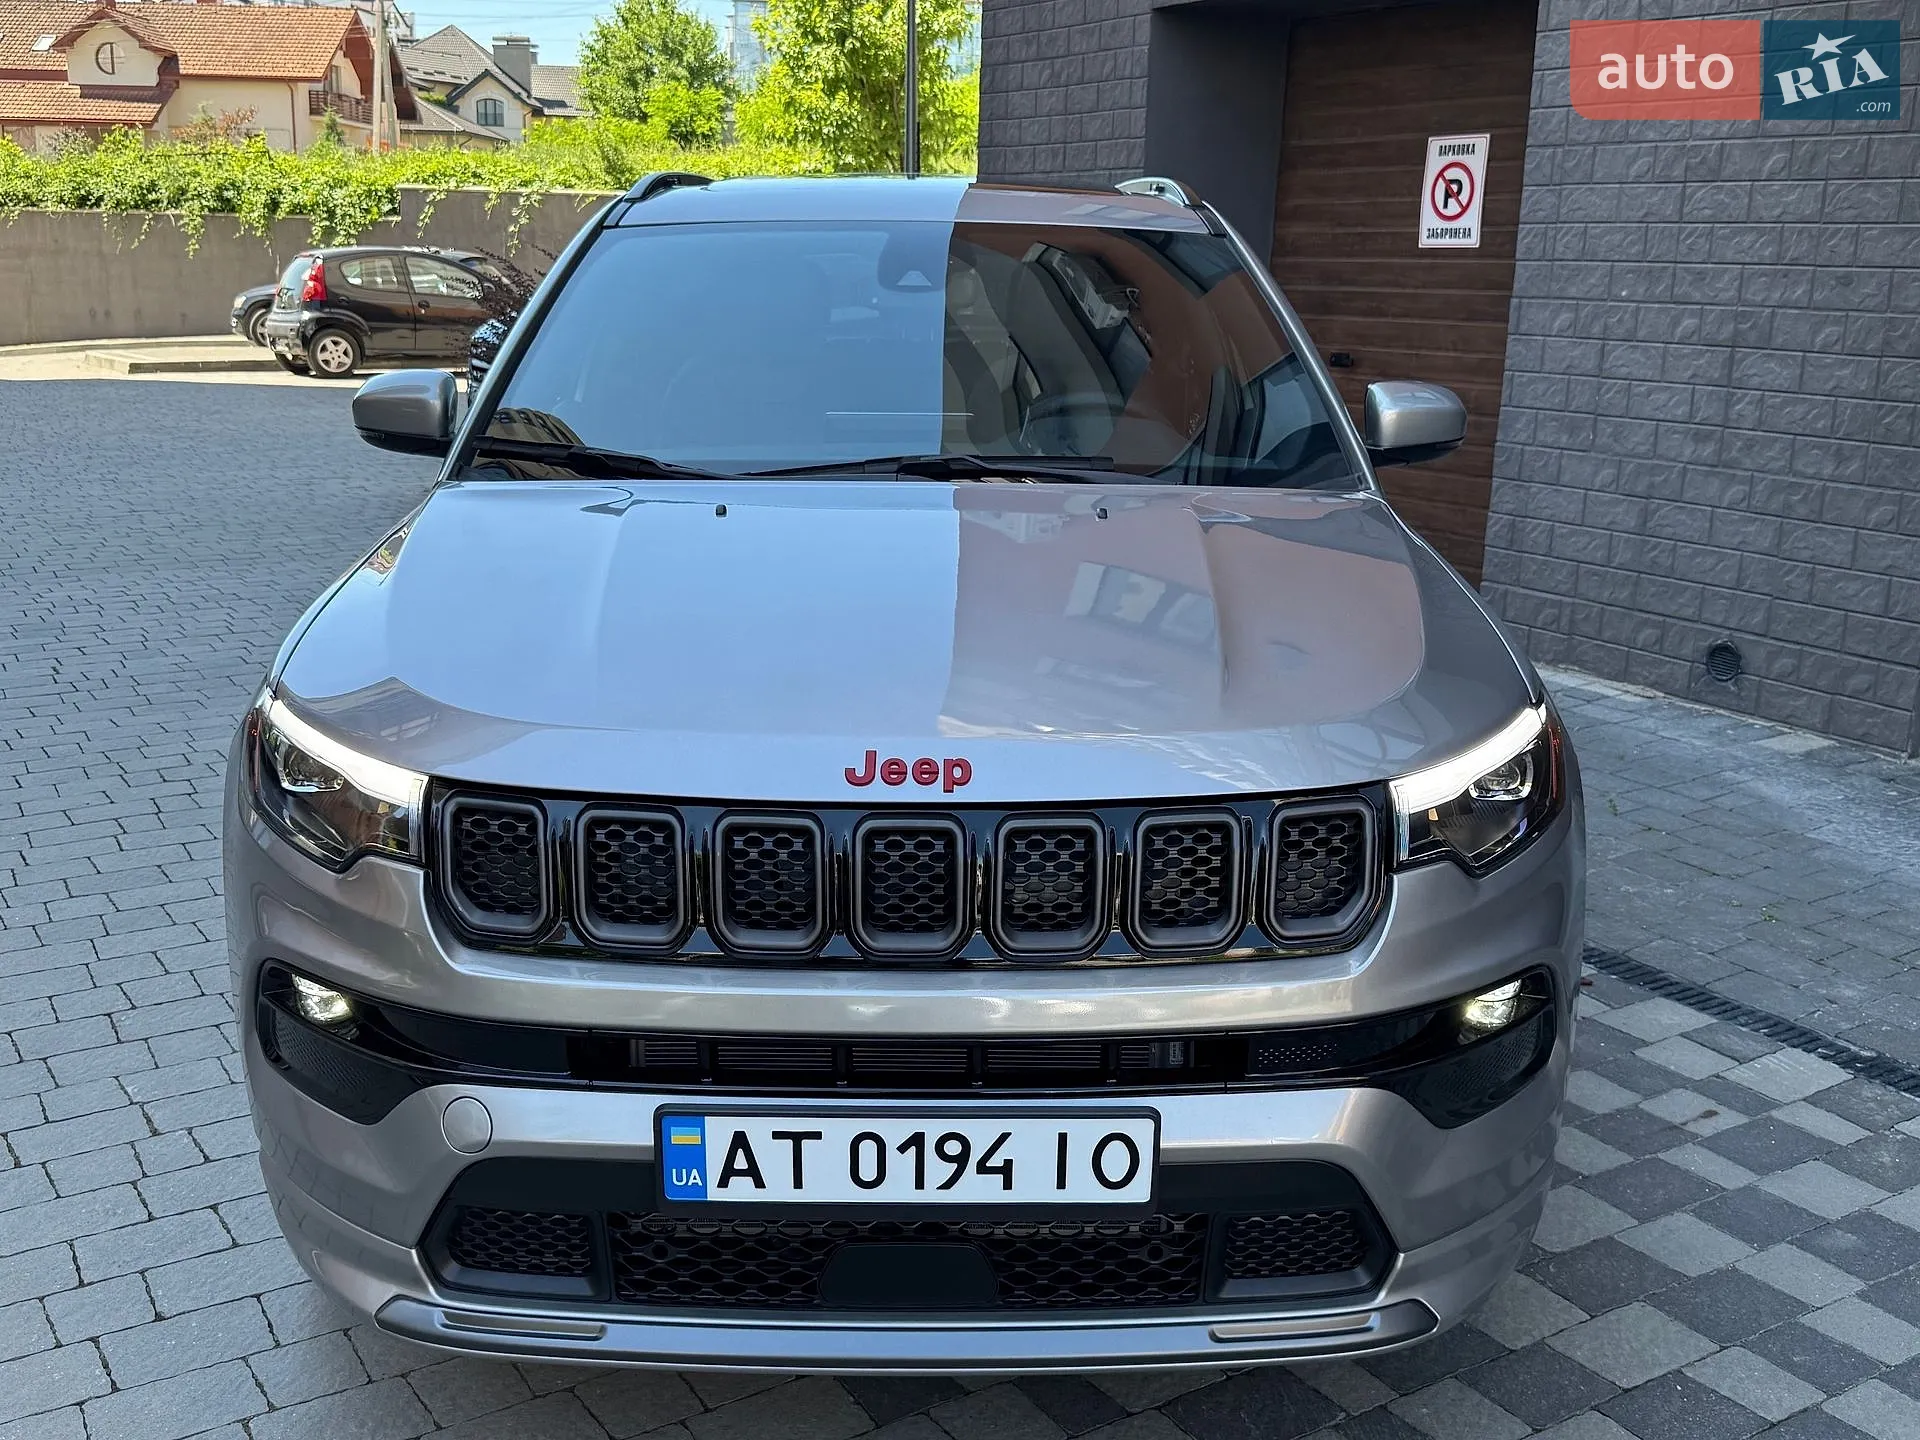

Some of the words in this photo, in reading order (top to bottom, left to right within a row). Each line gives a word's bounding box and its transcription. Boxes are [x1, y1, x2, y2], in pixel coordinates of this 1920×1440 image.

[1438, 143, 1476, 157] ПАРКОВКА
[1426, 227, 1472, 240] ЗАБОРОНЕНА
[844, 750, 972, 793] Jeep
[716, 1130, 823, 1190] AT
[849, 1131, 1014, 1191] 0194
[1055, 1131, 1141, 1190] IO
[672, 1168, 703, 1187] UA
